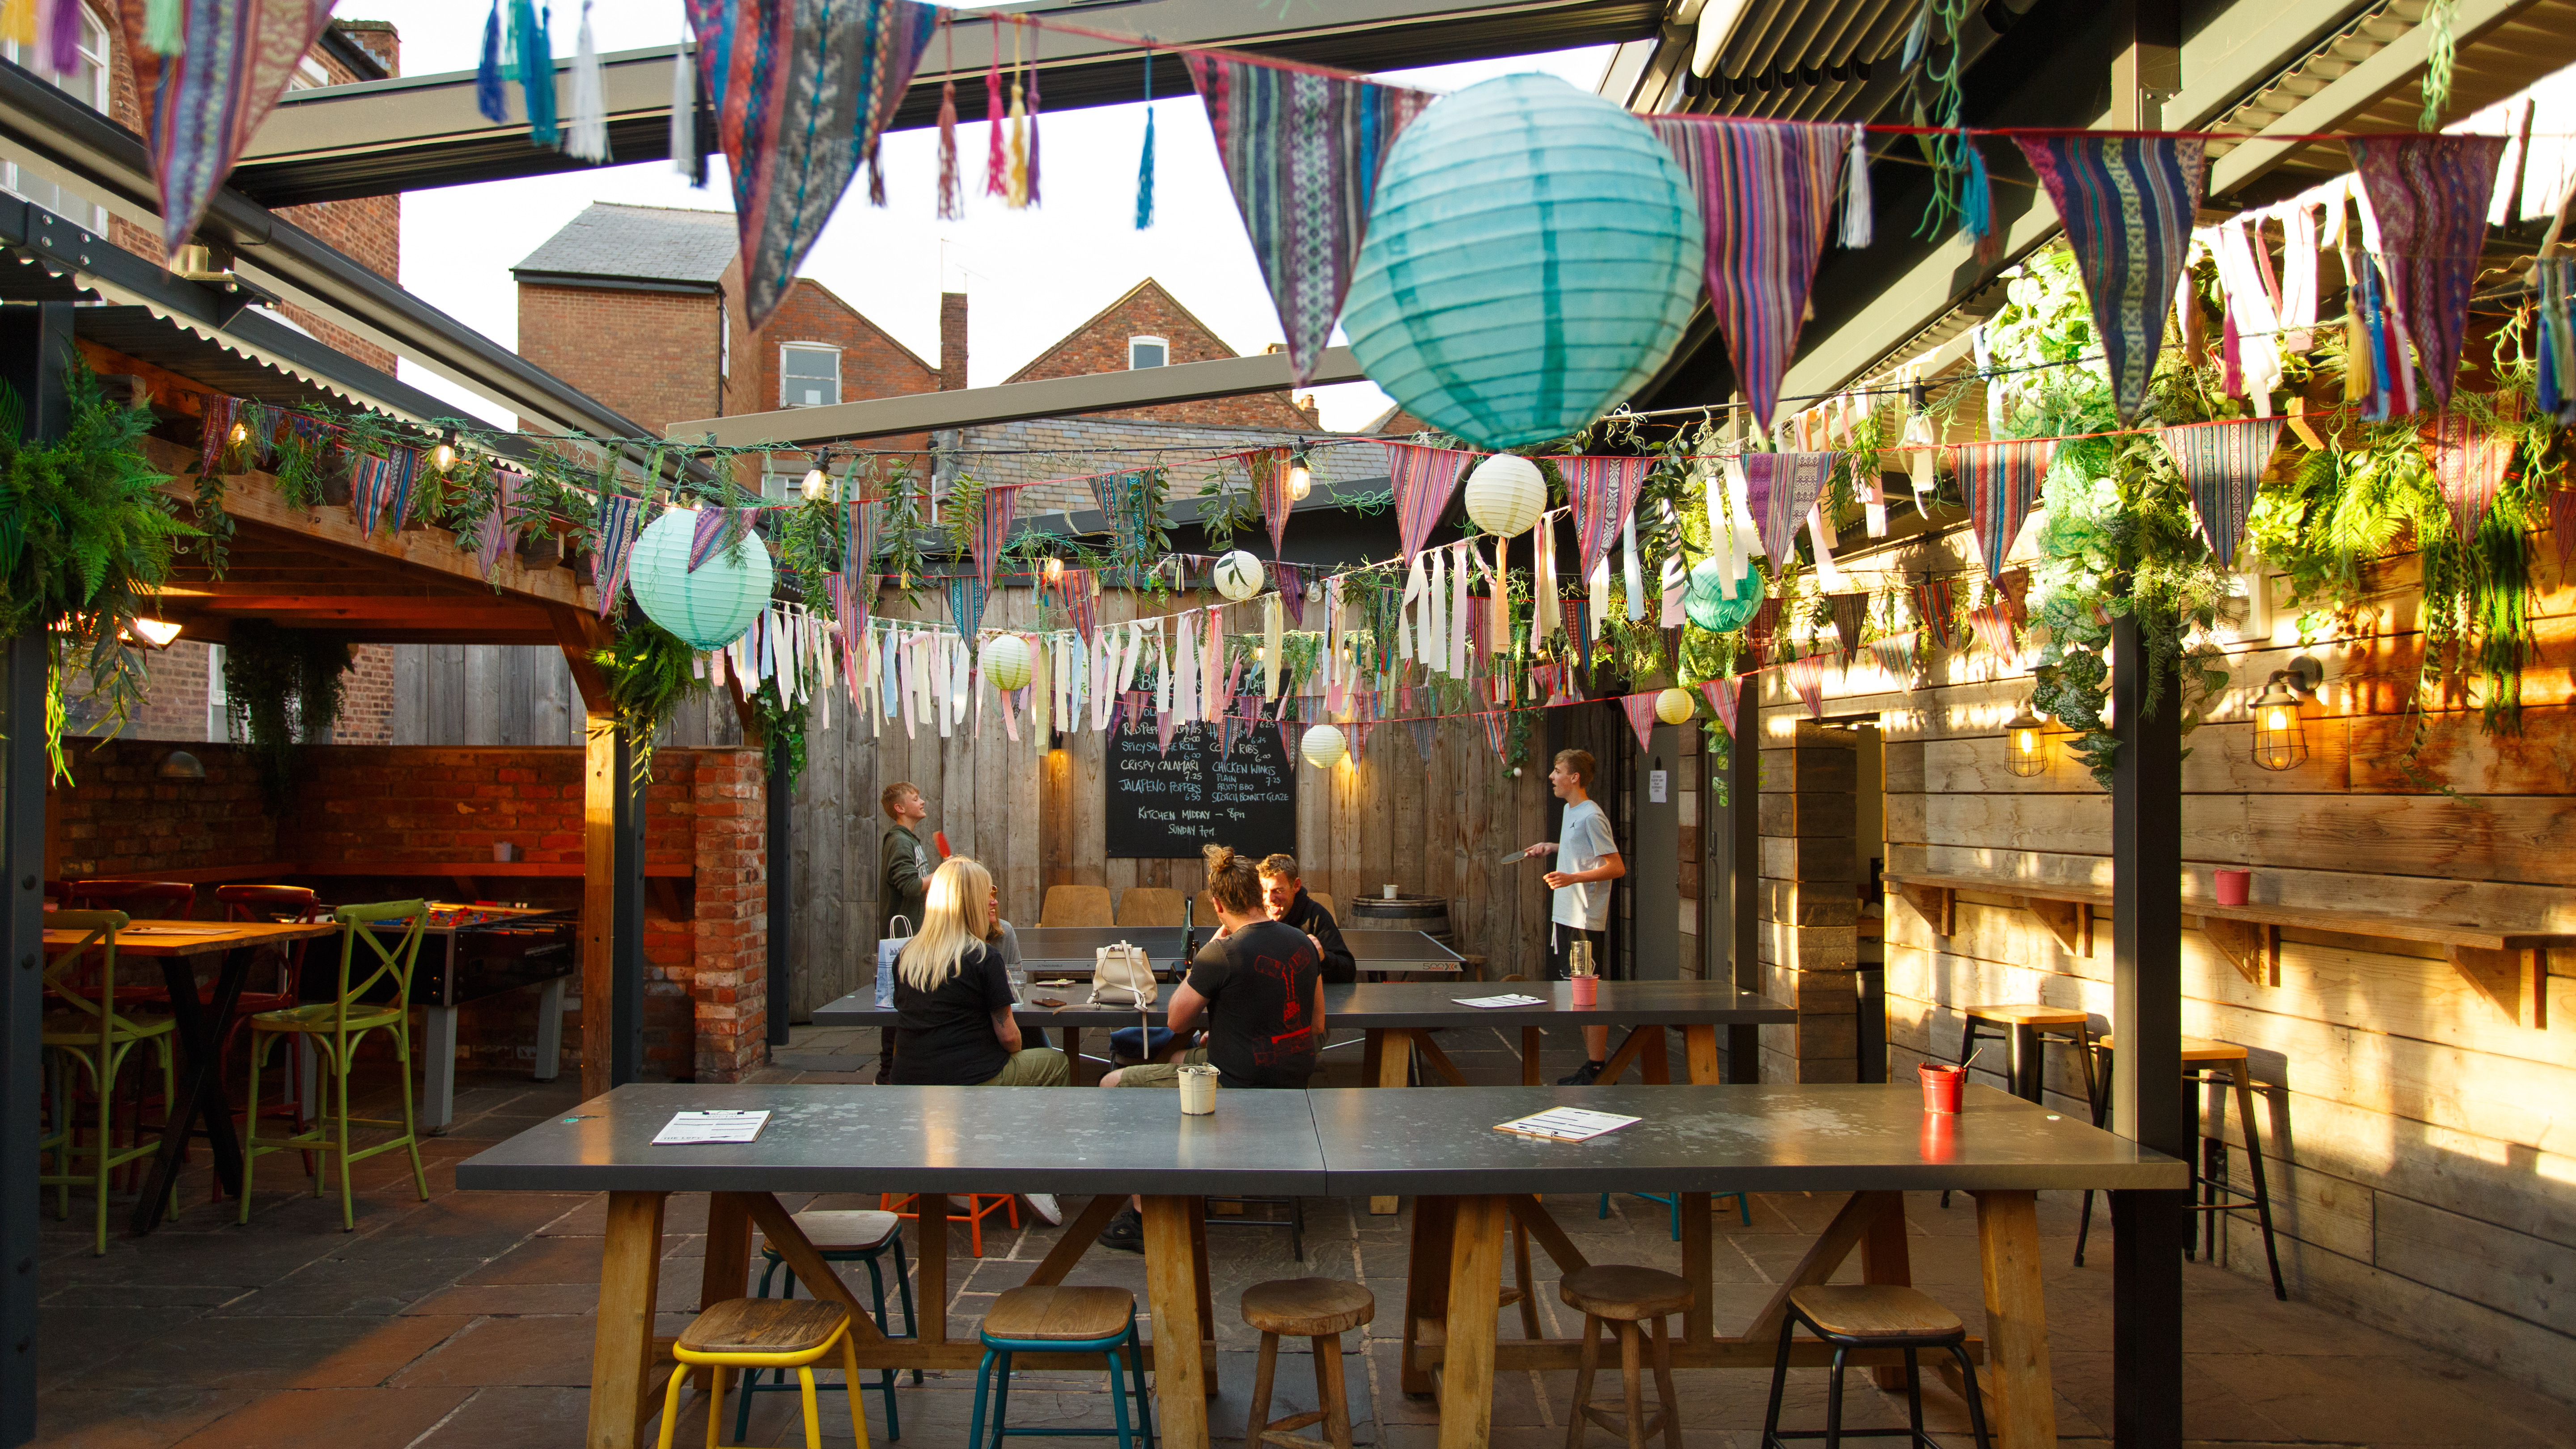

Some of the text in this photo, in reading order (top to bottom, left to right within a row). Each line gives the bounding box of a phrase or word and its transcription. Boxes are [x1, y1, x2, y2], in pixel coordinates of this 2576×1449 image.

[1122, 722, 1141, 736] RD
[1183, 735, 1200, 743] 6.00
[1122, 741, 1145, 754] SPICY
[1179, 740, 1198, 751] ROLL
[1239, 743, 1258, 754] RIBS
[1255, 754, 1271, 763] 6.00
[1121, 759, 1199, 773] CRISPY CALAMARI
[1212, 761, 1275, 776] CHICKEN WINGS
[1183, 771, 1202, 781] 7.25
[1216, 773, 1281, 787] PLAIN 7.25
[1118, 779, 1201, 795] JALAPENO POPPERS
[1217, 783, 1237, 791] FRUITY
[1212, 792, 1289, 803] SCOTCH BONNET GLAZE
[1139, 806, 1176, 821] KITCHEN
[1182, 809, 1210, 820] MIDDAY
[1168, 824, 1195, 836] SUNDAY
